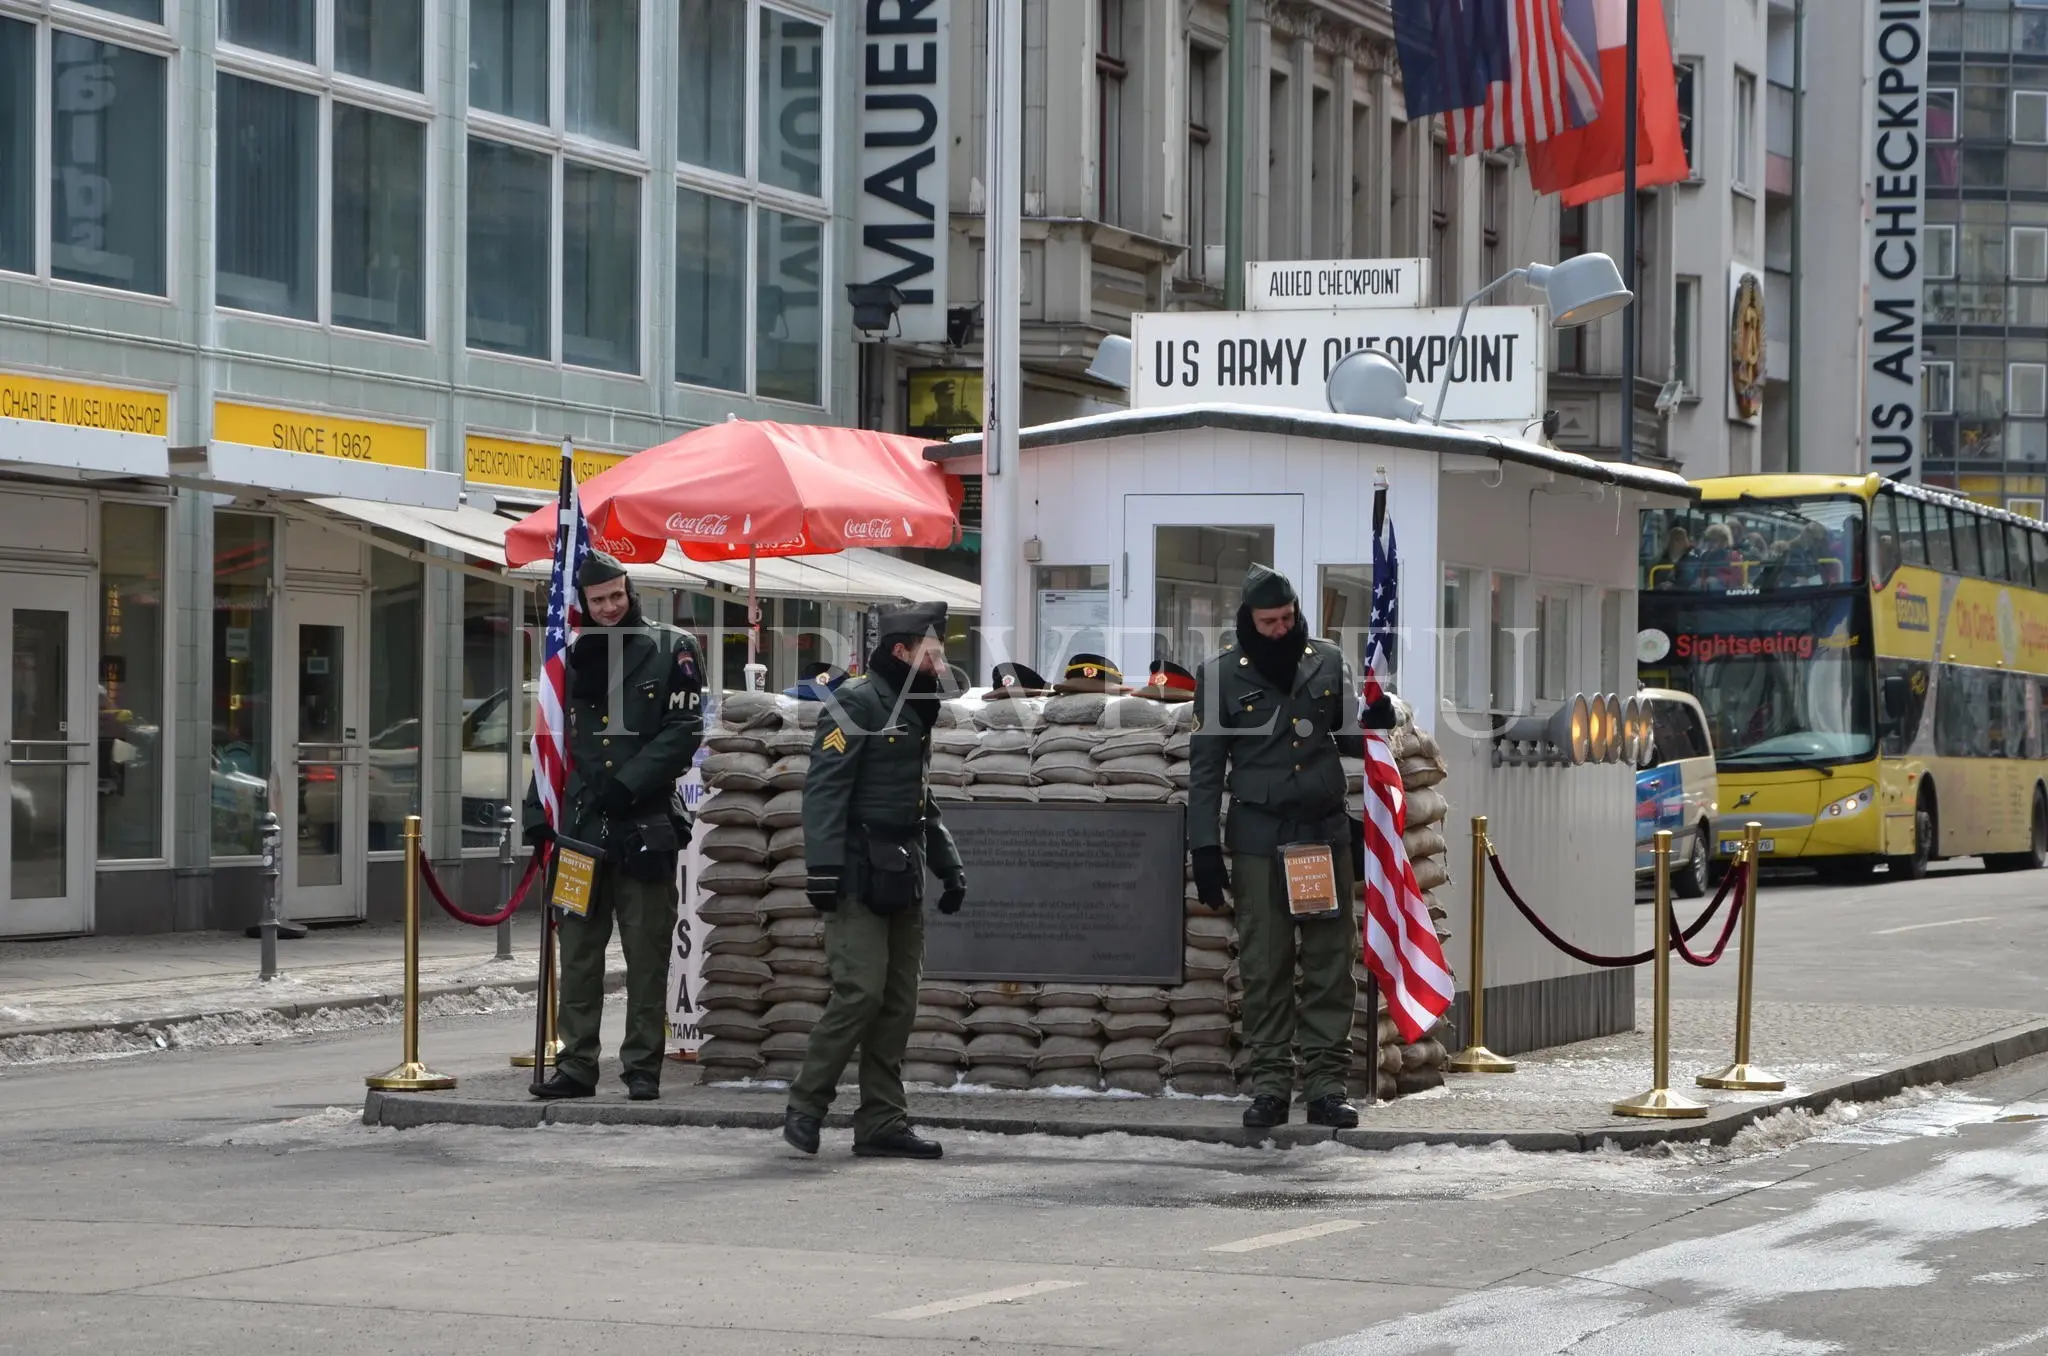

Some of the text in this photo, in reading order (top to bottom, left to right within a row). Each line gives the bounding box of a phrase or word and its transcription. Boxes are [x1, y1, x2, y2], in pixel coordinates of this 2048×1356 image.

[863, 0, 938, 305] MAUER
[1874, 0, 1922, 281] CHECKPOI
[1269, 268, 1402, 297] ALLIED CHECKPOINT
[1872, 300, 1915, 385] AM
[1155, 333, 1519, 388] US ARMY CCKPOINT
[2, 388, 161, 434] CHARLIE MUSEUMSSHOP
[272, 423, 373, 460] SINCE 1962
[467, 448, 525, 478] CHECKPOINT
[665, 511, 732, 536] Coca-Cola
[843, 517, 892, 538] Coca-Cola
[668, 690, 700, 710] MP
[1287, 855, 1328, 866] ERBITTEN
